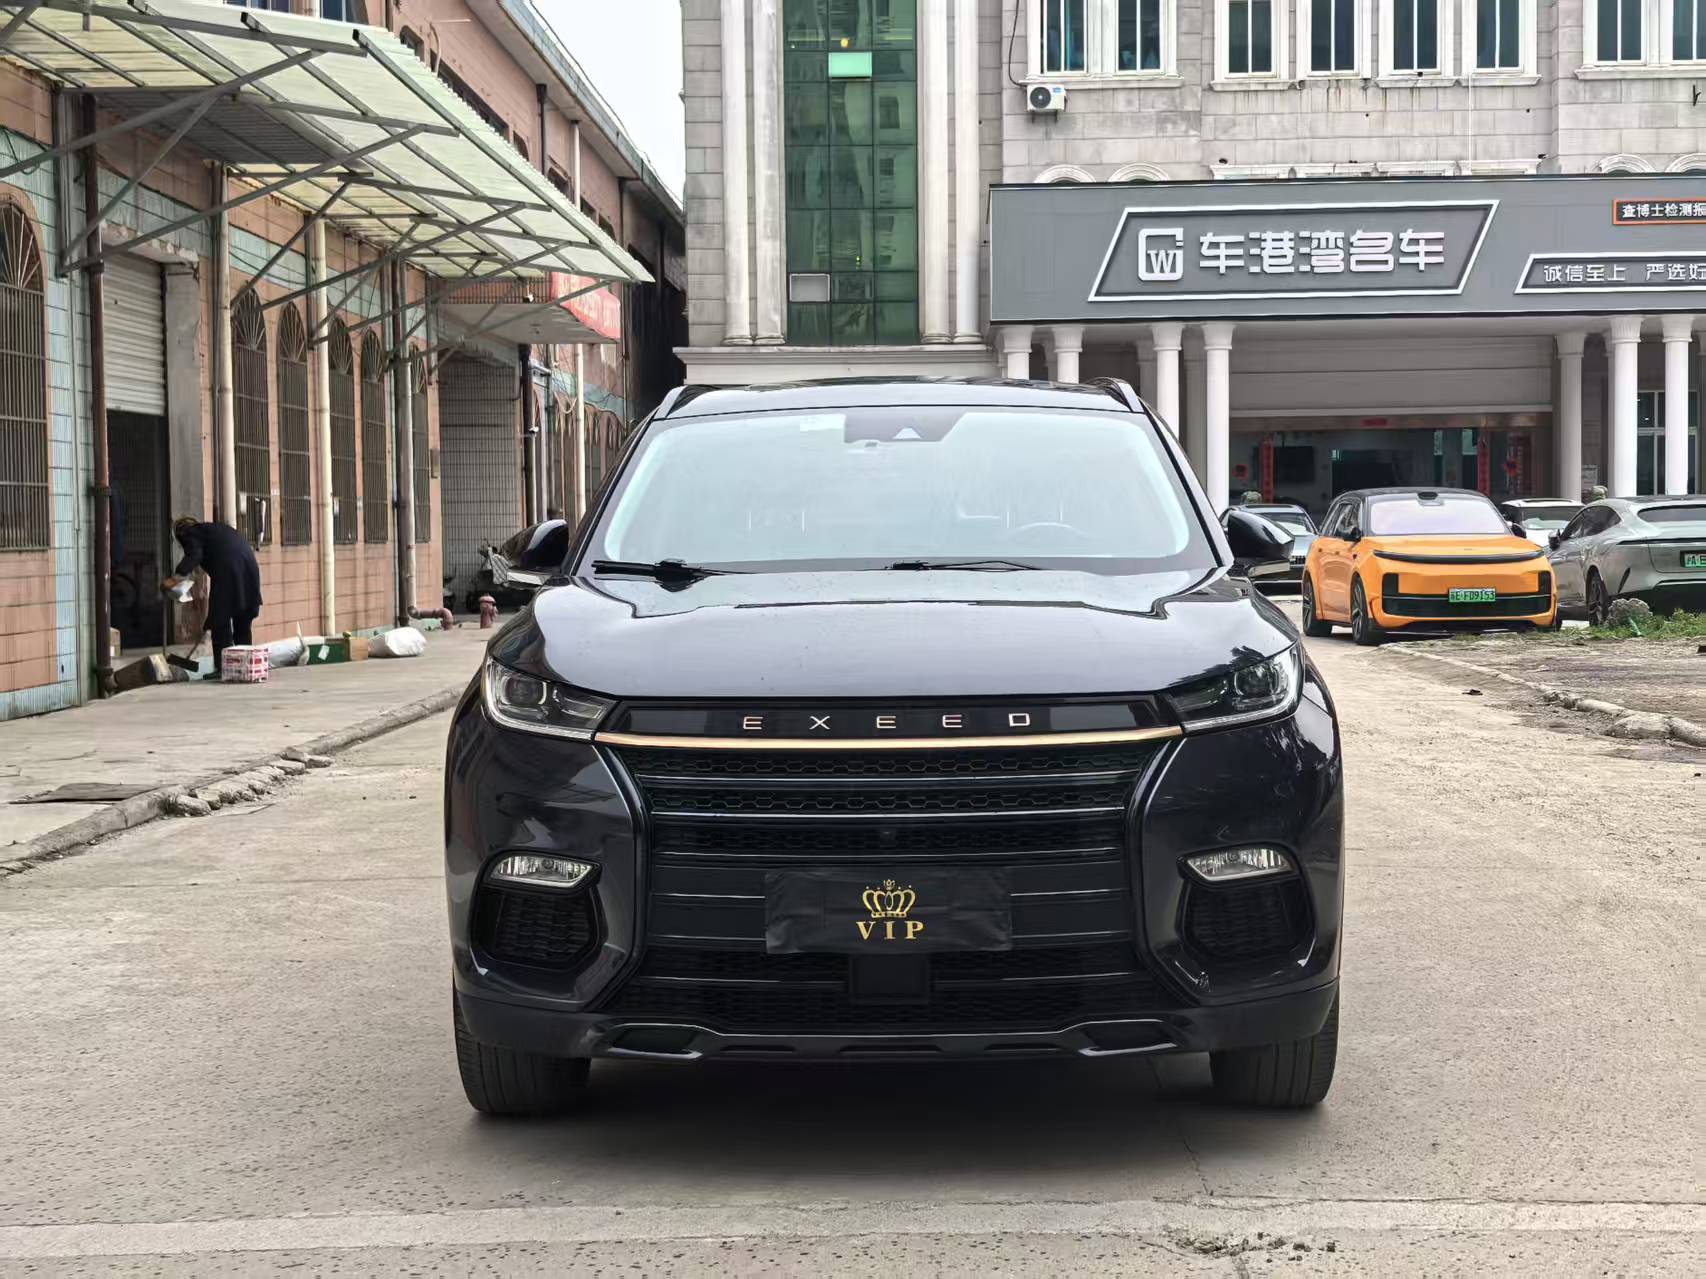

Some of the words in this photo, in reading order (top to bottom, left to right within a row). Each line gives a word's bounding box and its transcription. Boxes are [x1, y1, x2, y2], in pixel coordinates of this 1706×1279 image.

[1199, 229, 1445, 275] 车港湾名车
[1543, 264, 1627, 282] 诚信至上
[1646, 263, 1706, 281] 严选好
[743, 712, 1031, 731] EXEED
[855, 920, 925, 940] VIP
